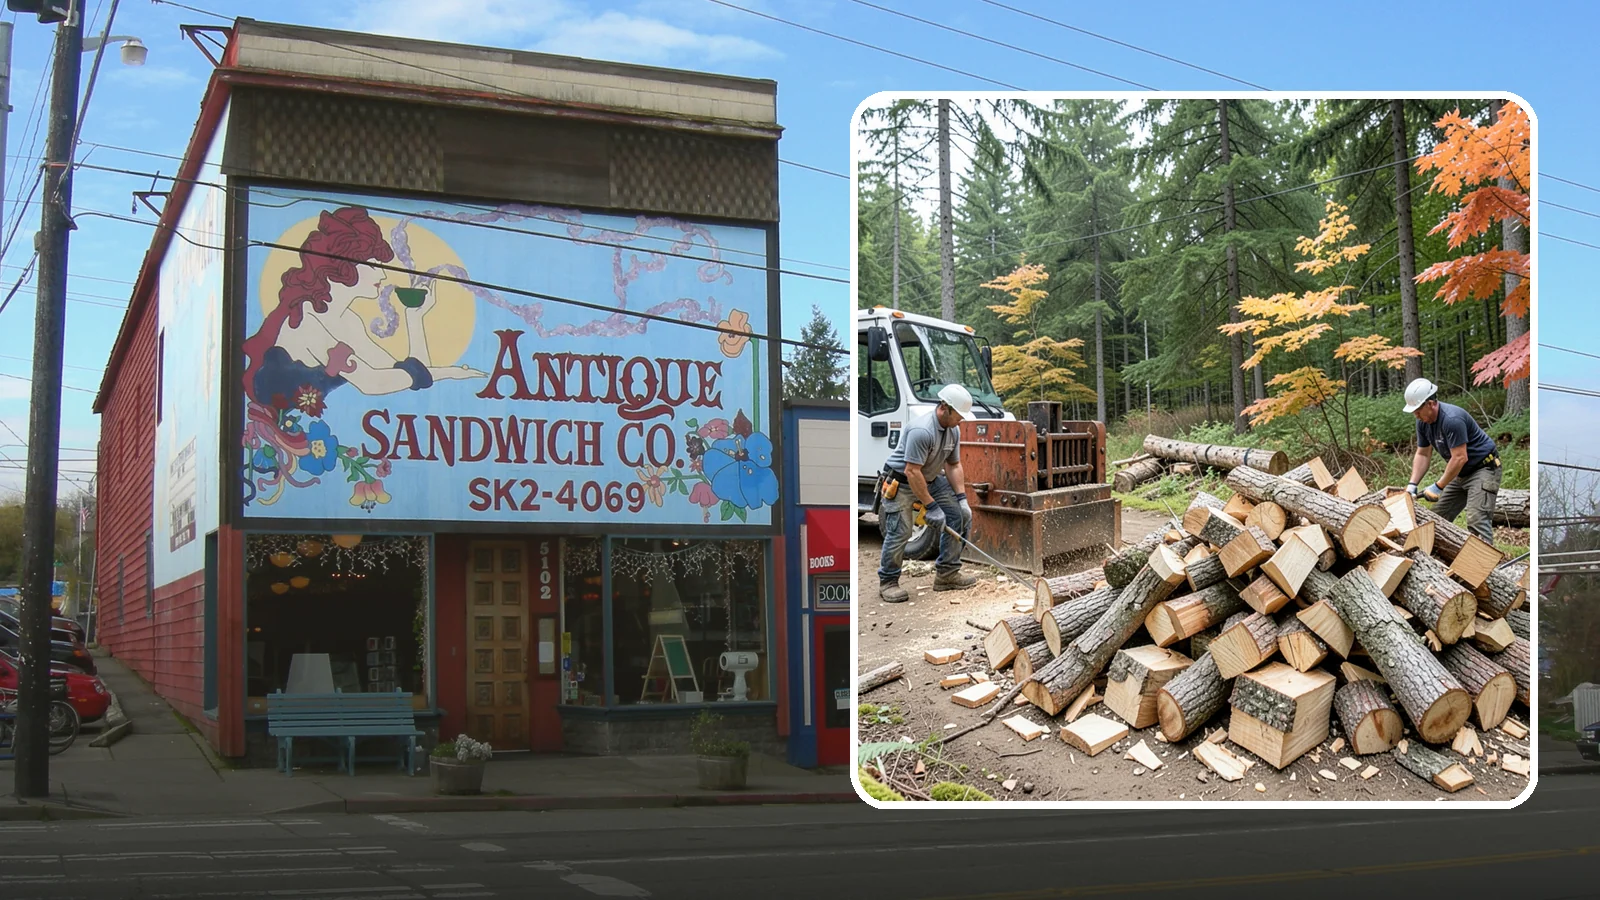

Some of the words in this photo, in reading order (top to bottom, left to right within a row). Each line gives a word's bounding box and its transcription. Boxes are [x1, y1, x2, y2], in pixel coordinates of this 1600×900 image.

[475, 328, 724, 421] ANTIQUE
[361, 408, 604, 467] SANDWICH
[616, 421, 685, 470] CO.
[468, 477, 646, 513] SK2-4069
[539, 541, 552, 600] 5102
[809, 555, 835, 569] BOOKS
